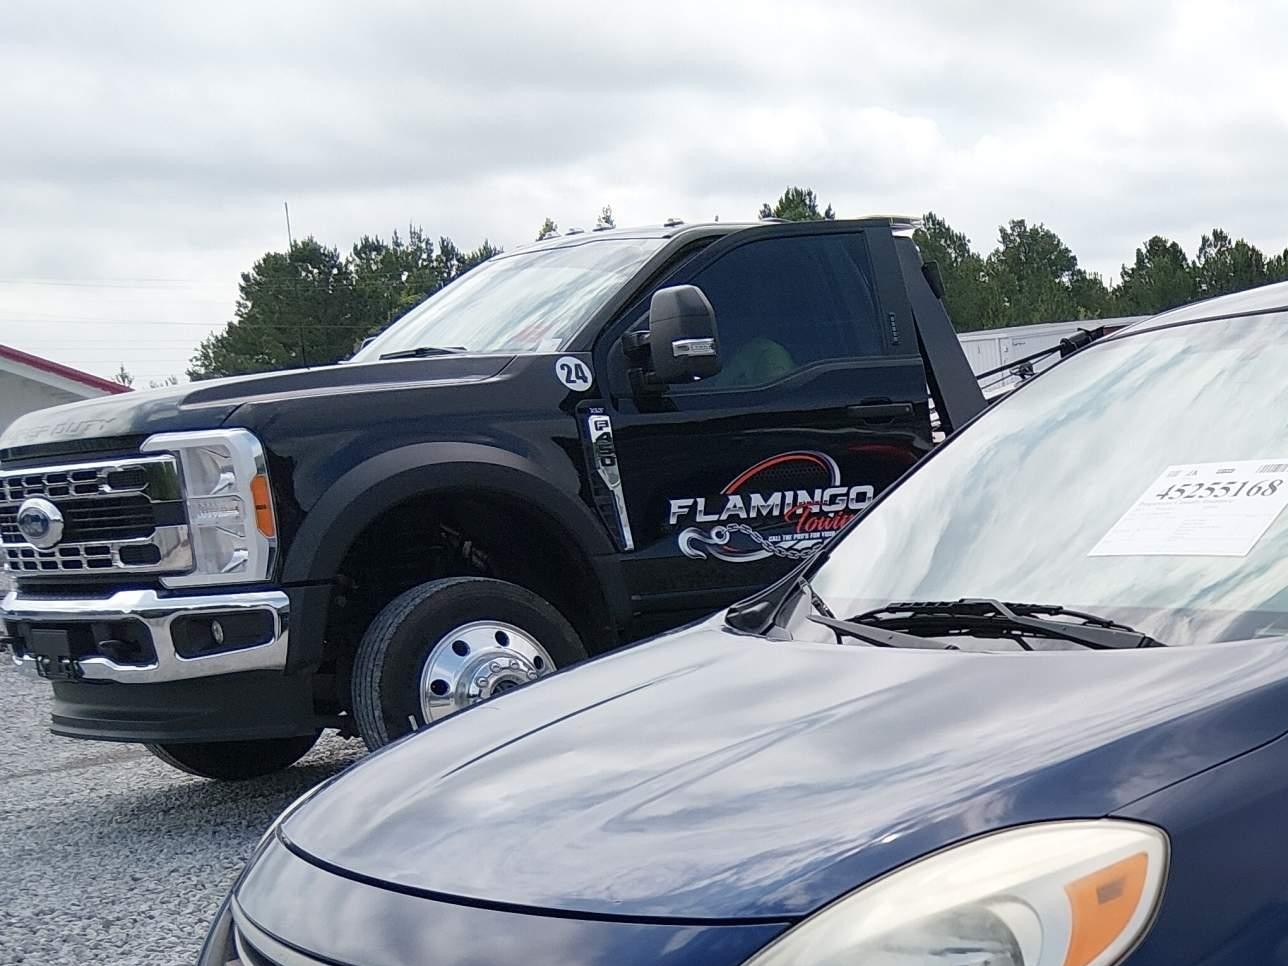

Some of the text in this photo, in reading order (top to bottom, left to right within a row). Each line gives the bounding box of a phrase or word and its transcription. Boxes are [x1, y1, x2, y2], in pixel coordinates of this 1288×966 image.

[560, 363, 588, 384] 24
[1155, 478, 1284, 500] 45255168
[669, 485, 874, 524] FLAMINGO
